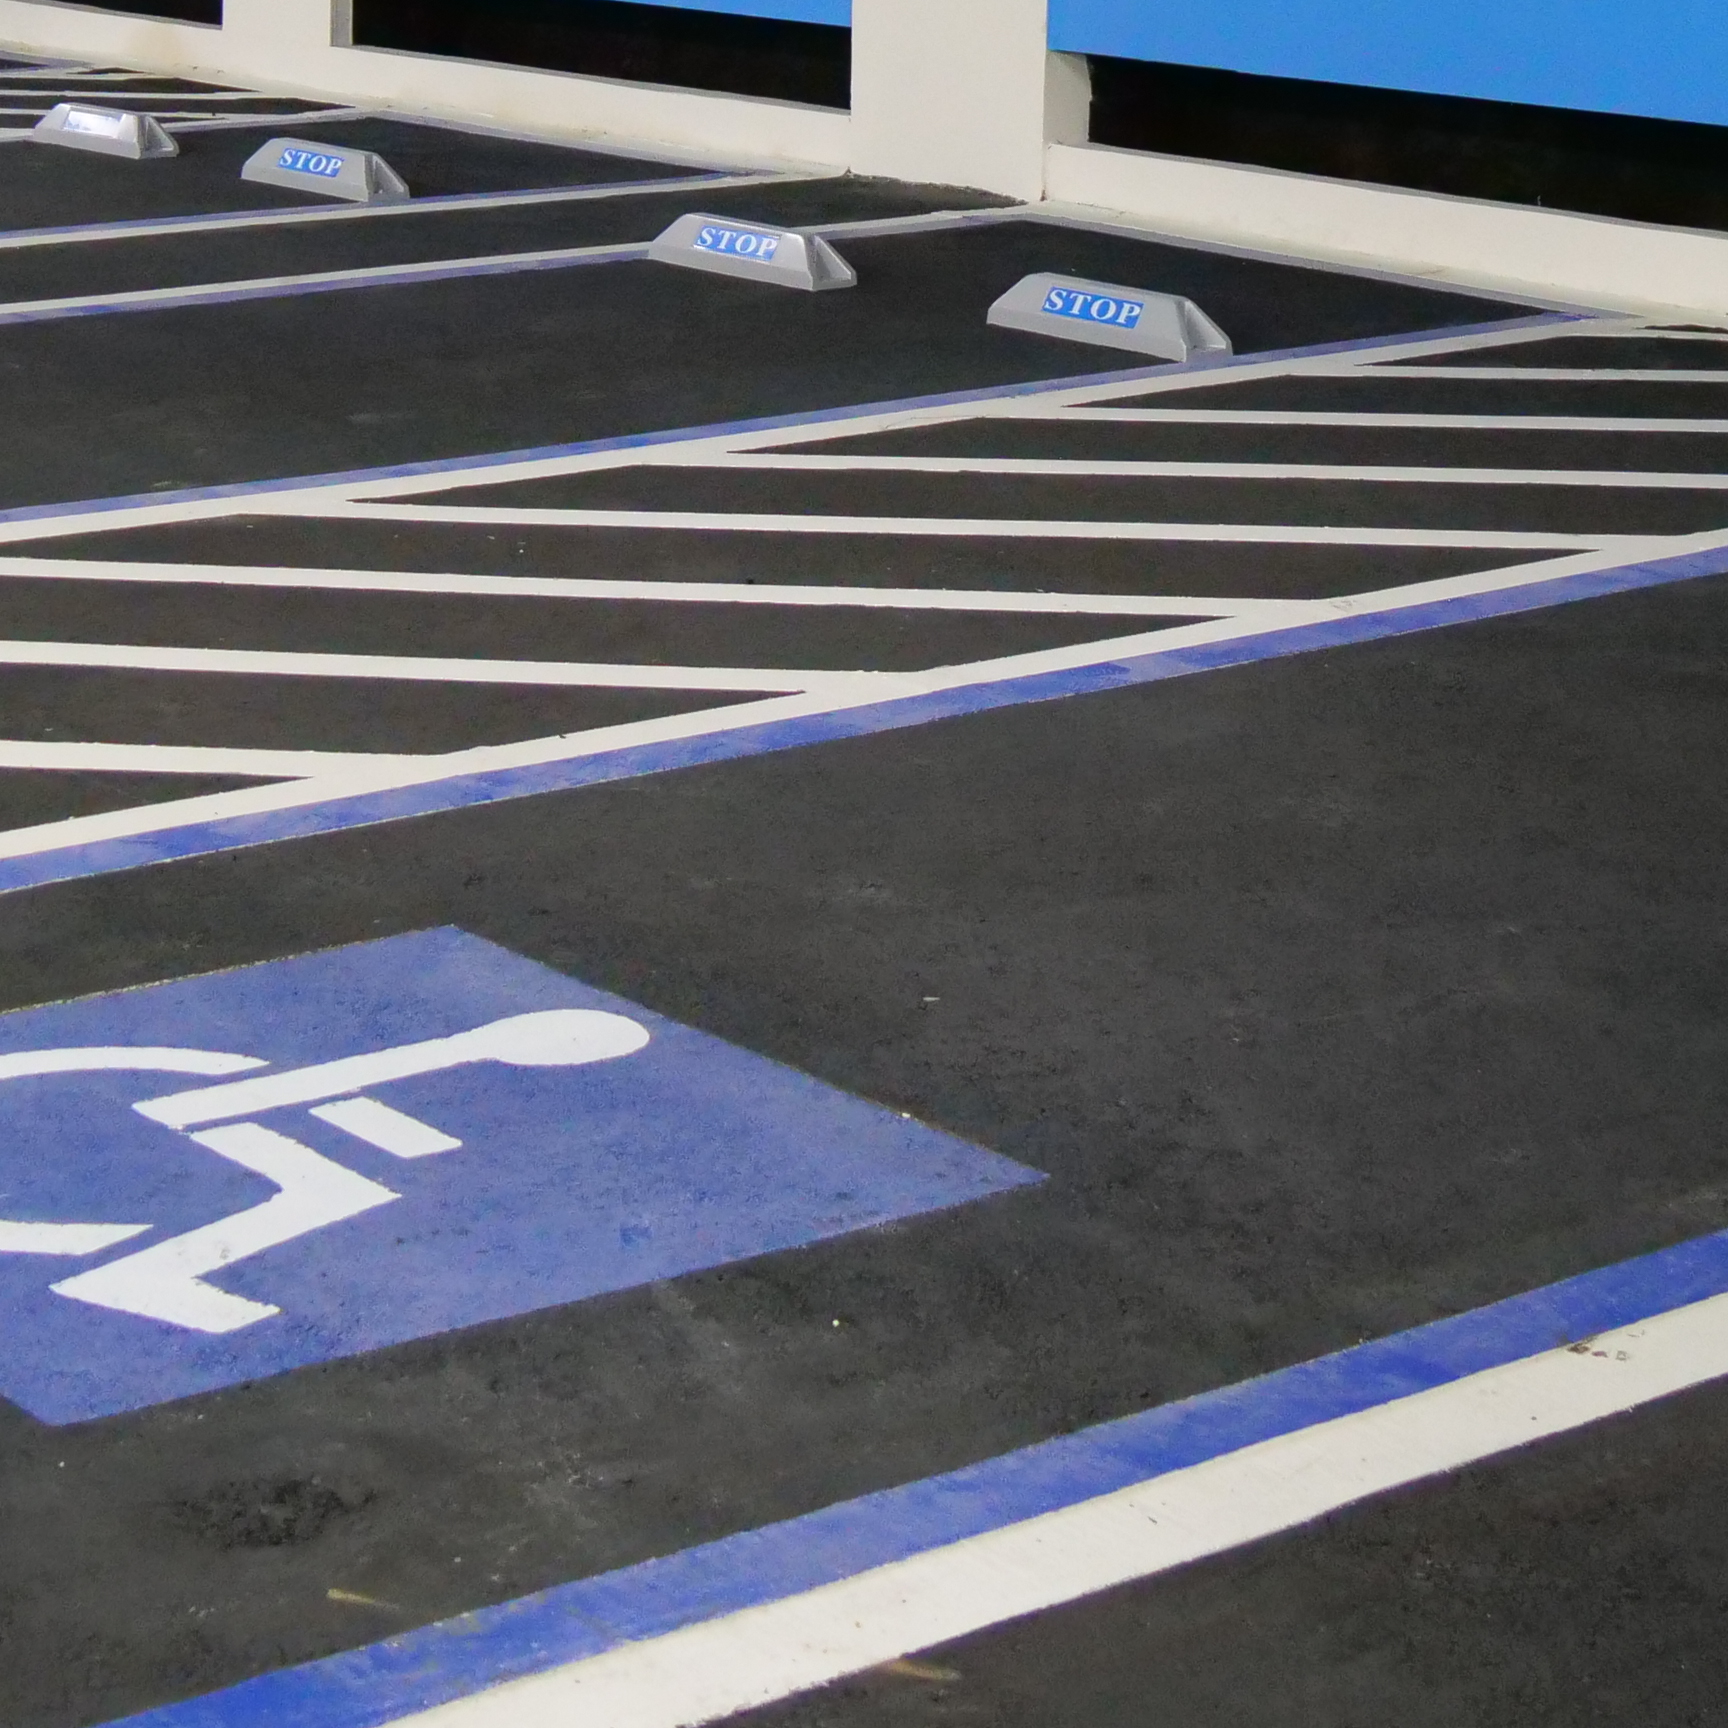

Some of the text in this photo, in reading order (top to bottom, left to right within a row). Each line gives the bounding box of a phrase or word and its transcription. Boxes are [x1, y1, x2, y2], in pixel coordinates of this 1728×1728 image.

[280, 147, 342, 176] STOP
[697, 225, 777, 258] STOP
[1045, 286, 1142, 327] STOP
